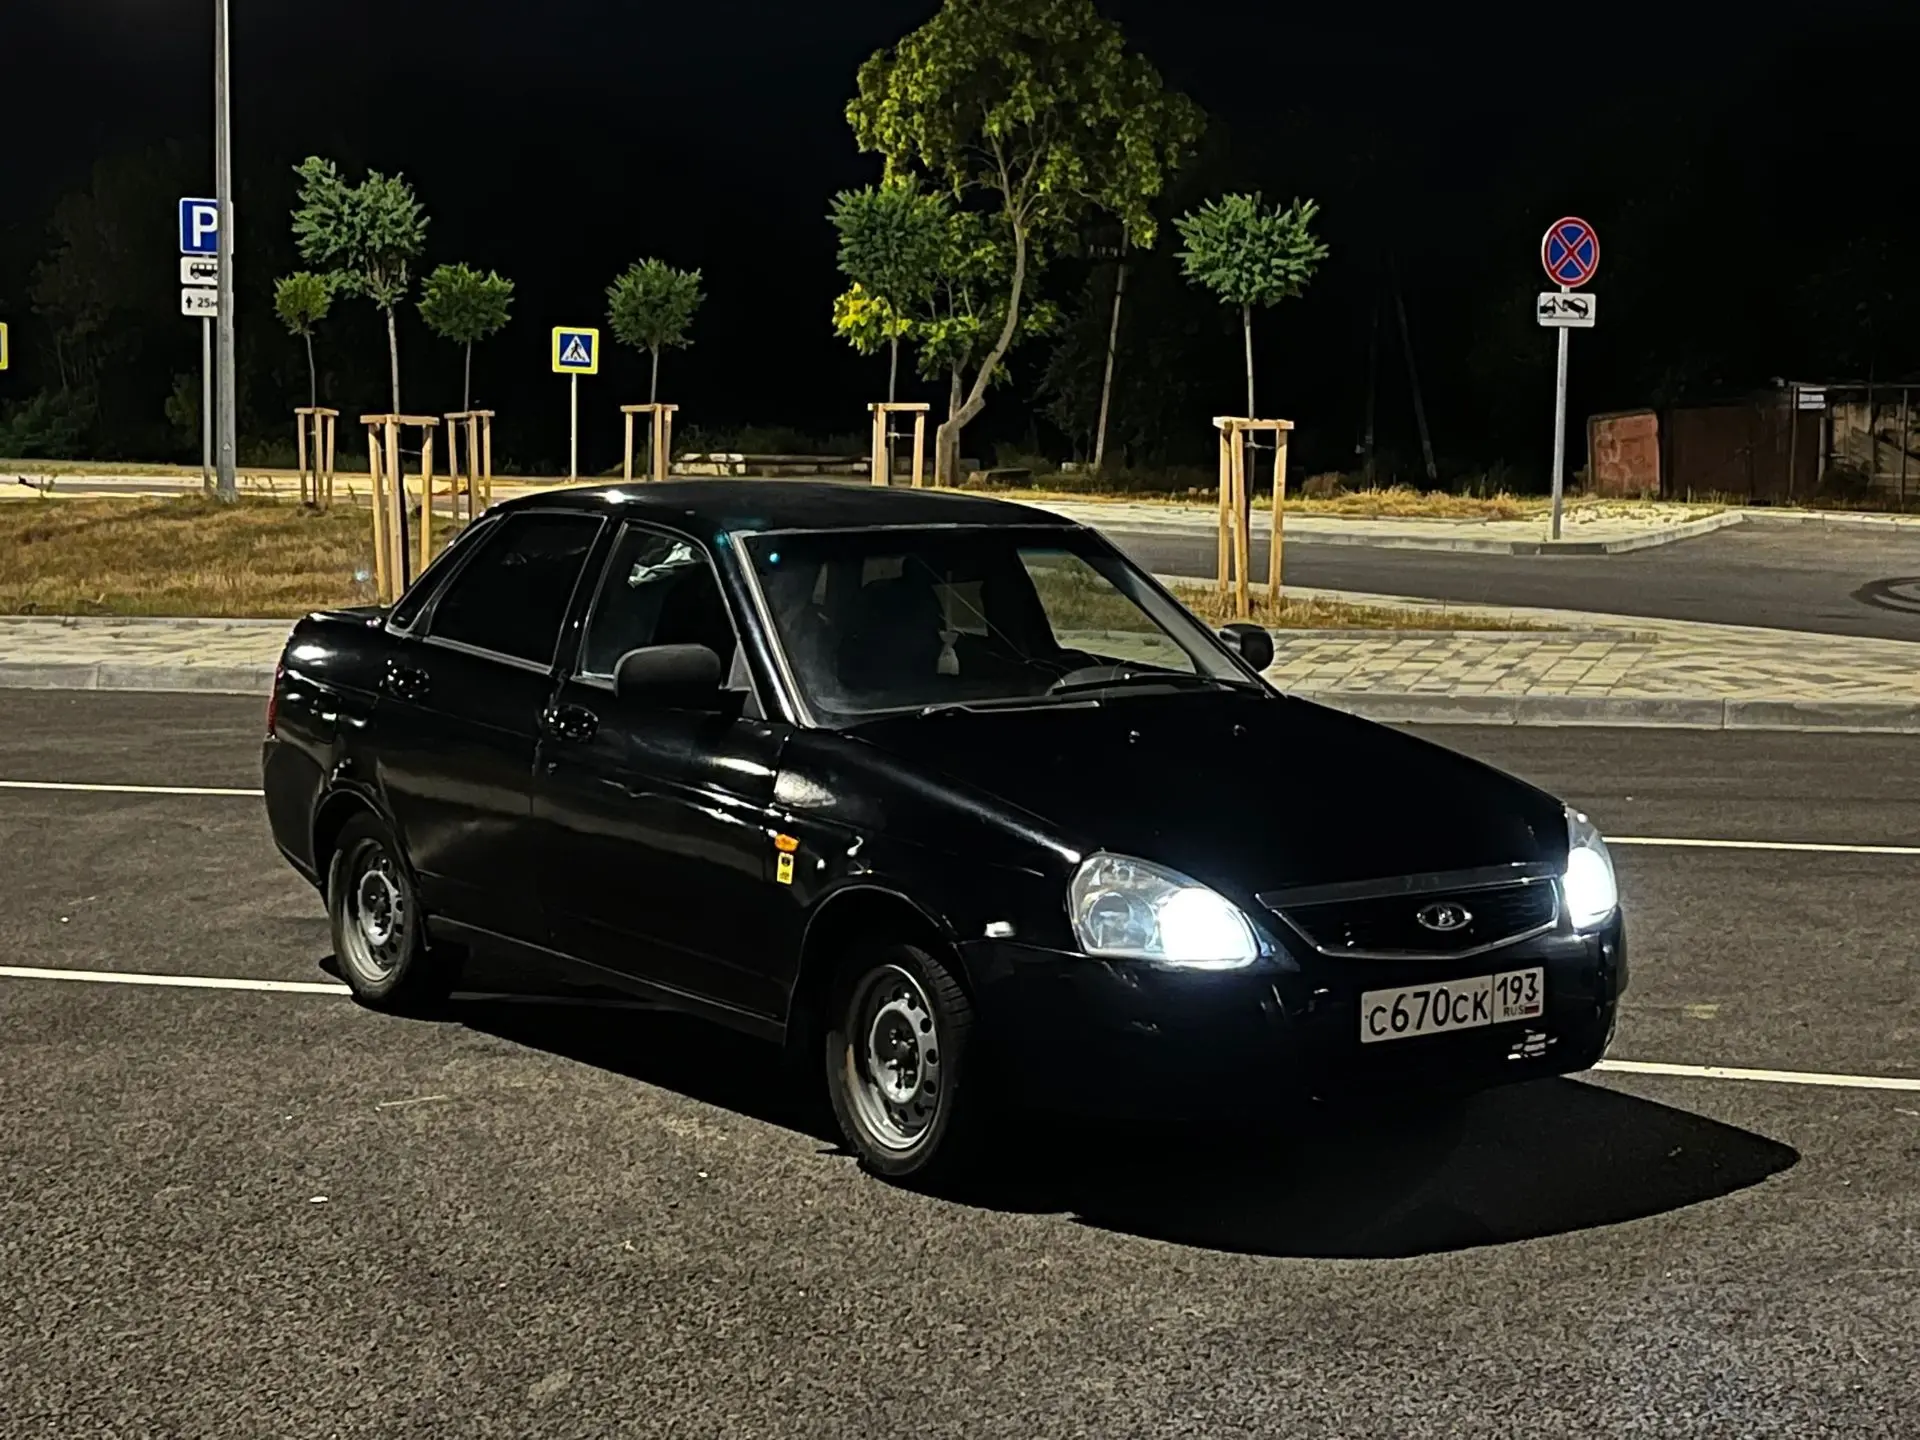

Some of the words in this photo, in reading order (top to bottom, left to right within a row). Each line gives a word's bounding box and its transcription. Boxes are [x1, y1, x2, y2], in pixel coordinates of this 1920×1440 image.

[192, 205, 218, 247] P
[1369, 988, 1489, 1036] С670СК
[1496, 972, 1538, 1006] 193
[1503, 1004, 1524, 1017] RUS
